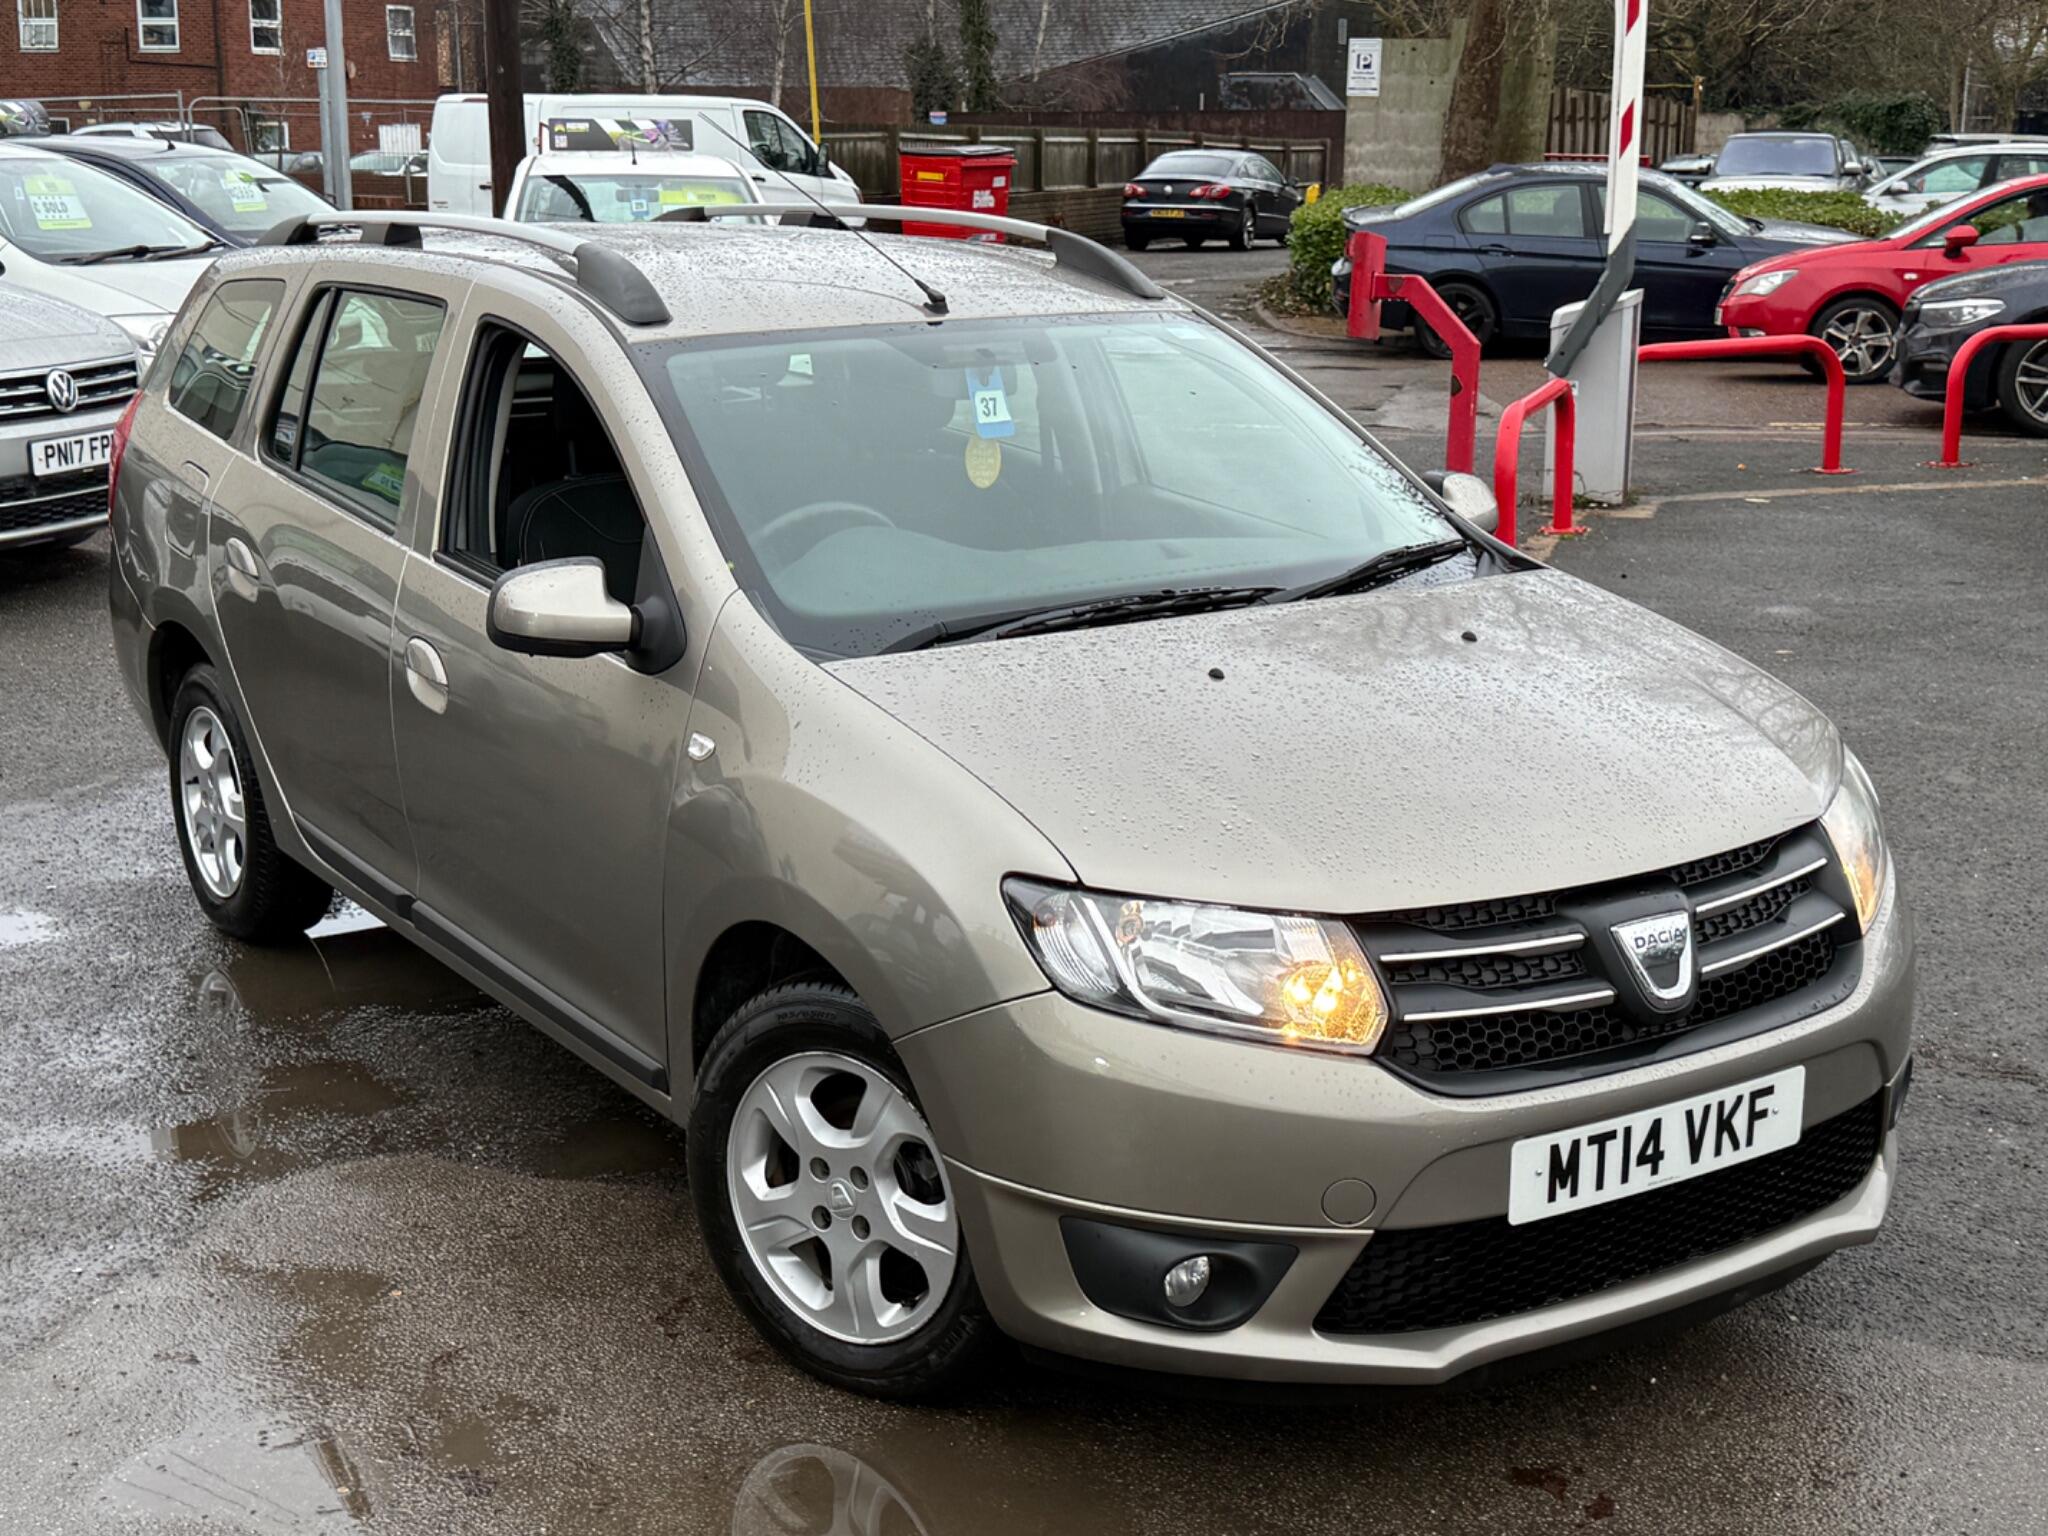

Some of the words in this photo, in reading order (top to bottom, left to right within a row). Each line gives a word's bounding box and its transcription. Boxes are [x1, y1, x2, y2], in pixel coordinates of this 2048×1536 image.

[980, 397, 998, 417] 37
[44, 440, 84, 469] PN17
[89, 434, 114, 461] FP
[1634, 928, 1687, 949] DACIA
[1547, 1117, 1665, 1203] MT14
[1685, 1084, 1775, 1165] VKF
